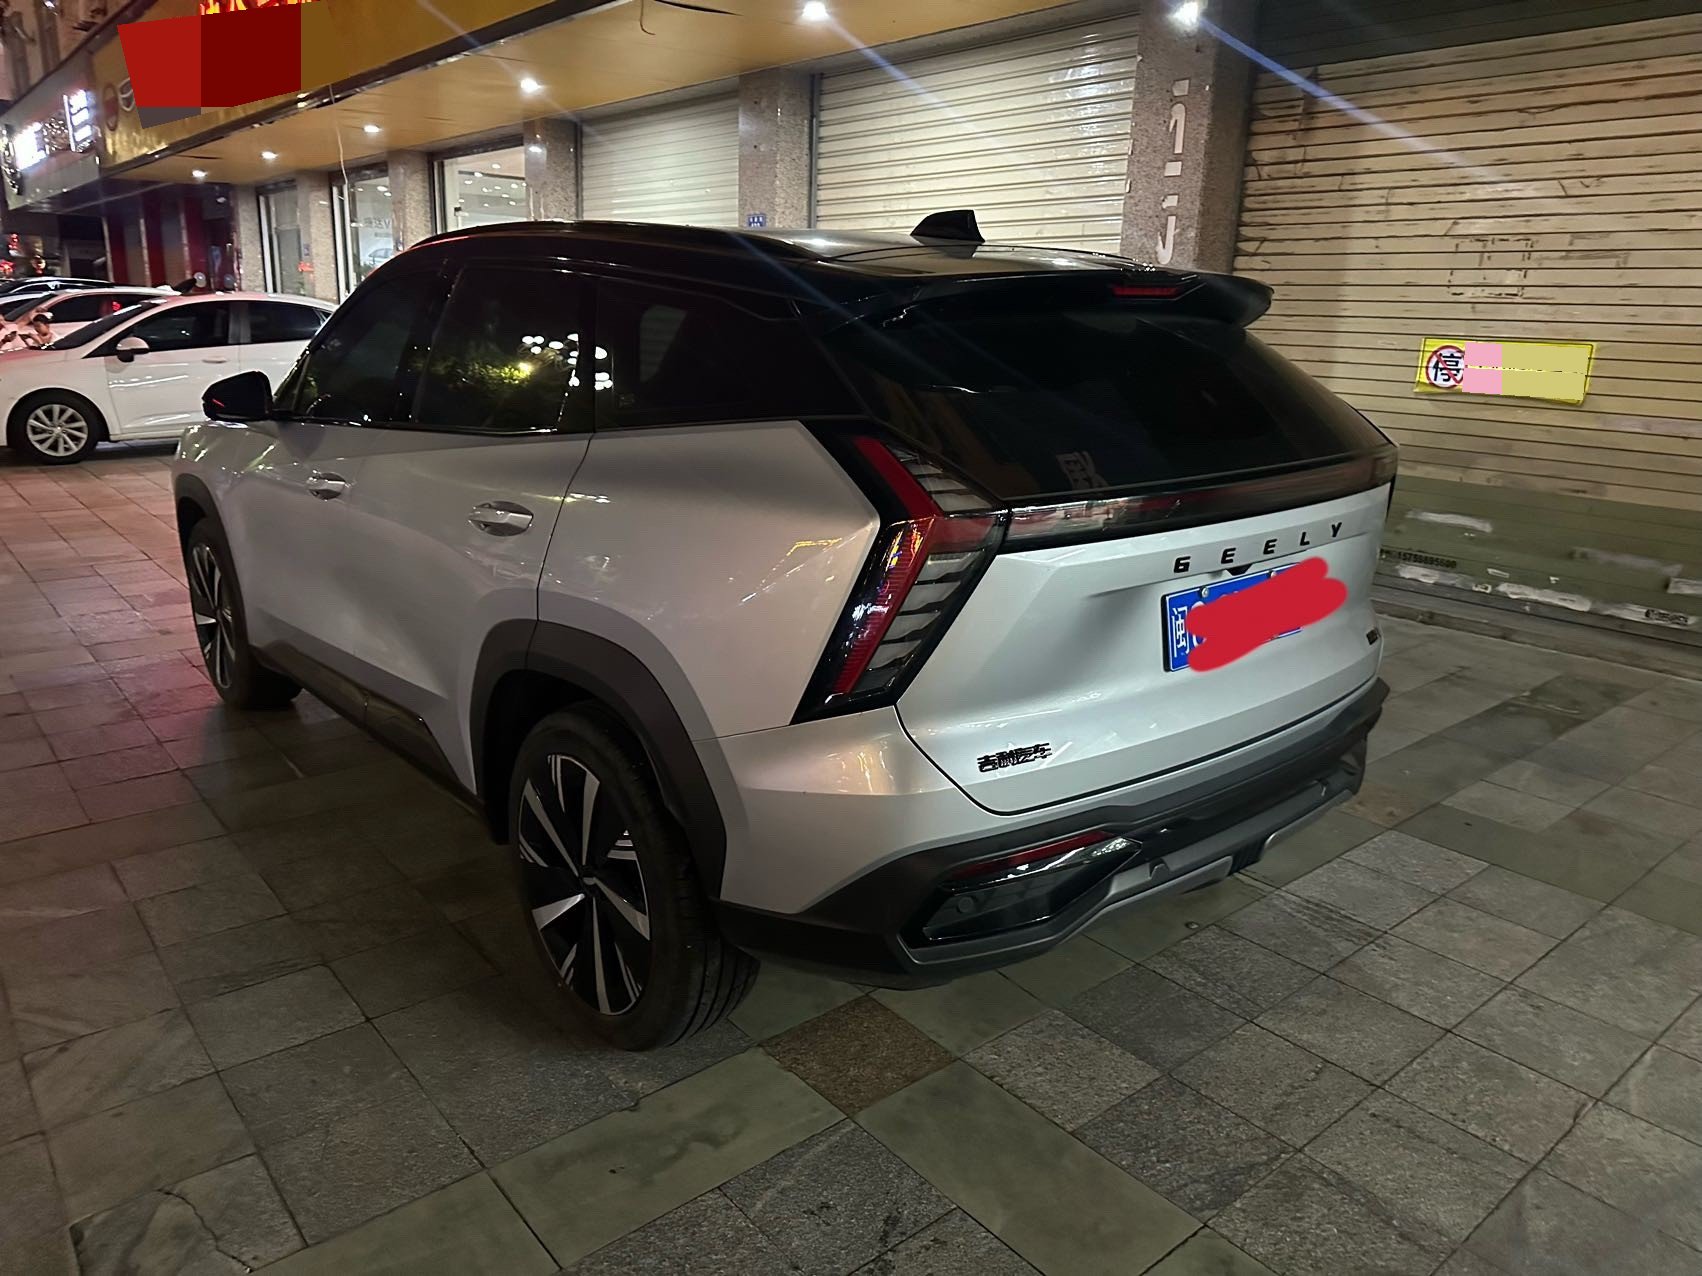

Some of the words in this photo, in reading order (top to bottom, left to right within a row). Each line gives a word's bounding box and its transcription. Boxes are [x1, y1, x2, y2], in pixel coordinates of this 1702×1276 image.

[1432, 352, 1464, 383] 停
[1173, 522, 1342, 574] GEELY
[976, 743, 1053, 773] 吉利汽车
